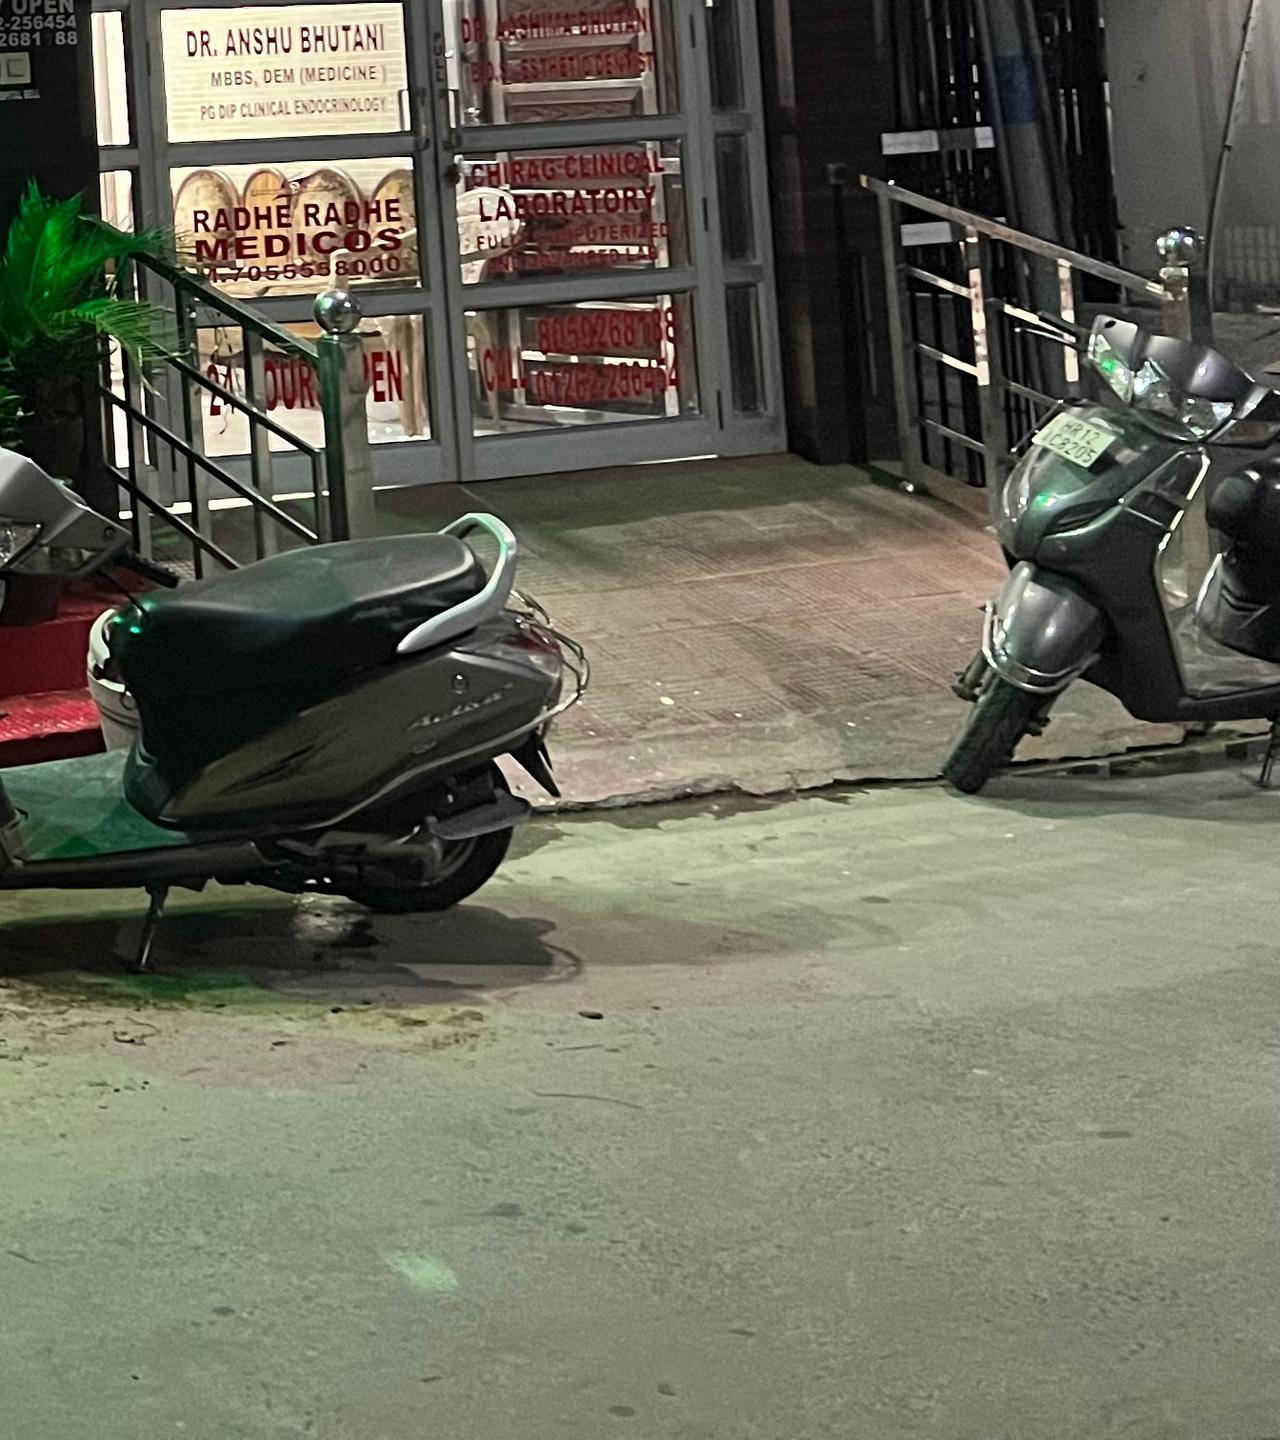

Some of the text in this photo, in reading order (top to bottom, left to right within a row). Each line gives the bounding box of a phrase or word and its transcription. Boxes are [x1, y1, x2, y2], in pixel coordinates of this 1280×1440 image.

[54, 29, 78, 47] 88
[186, 23, 386, 58] DR. ANSHU BHUTANI
[210, 70, 259, 88] MBBS,
[263, 68, 295, 84] DEM
[200, 96, 386, 121] PG DIP CLINICAL ENDOCRINOLOGY
[470, 149, 666, 188] CHIRAG CLINICAL
[193, 198, 403, 234] RADHE RADHE
[478, 185, 657, 223] LABORATORY
[195, 227, 403, 263] MEDICOS
[482, 346, 529, 393] CALL
